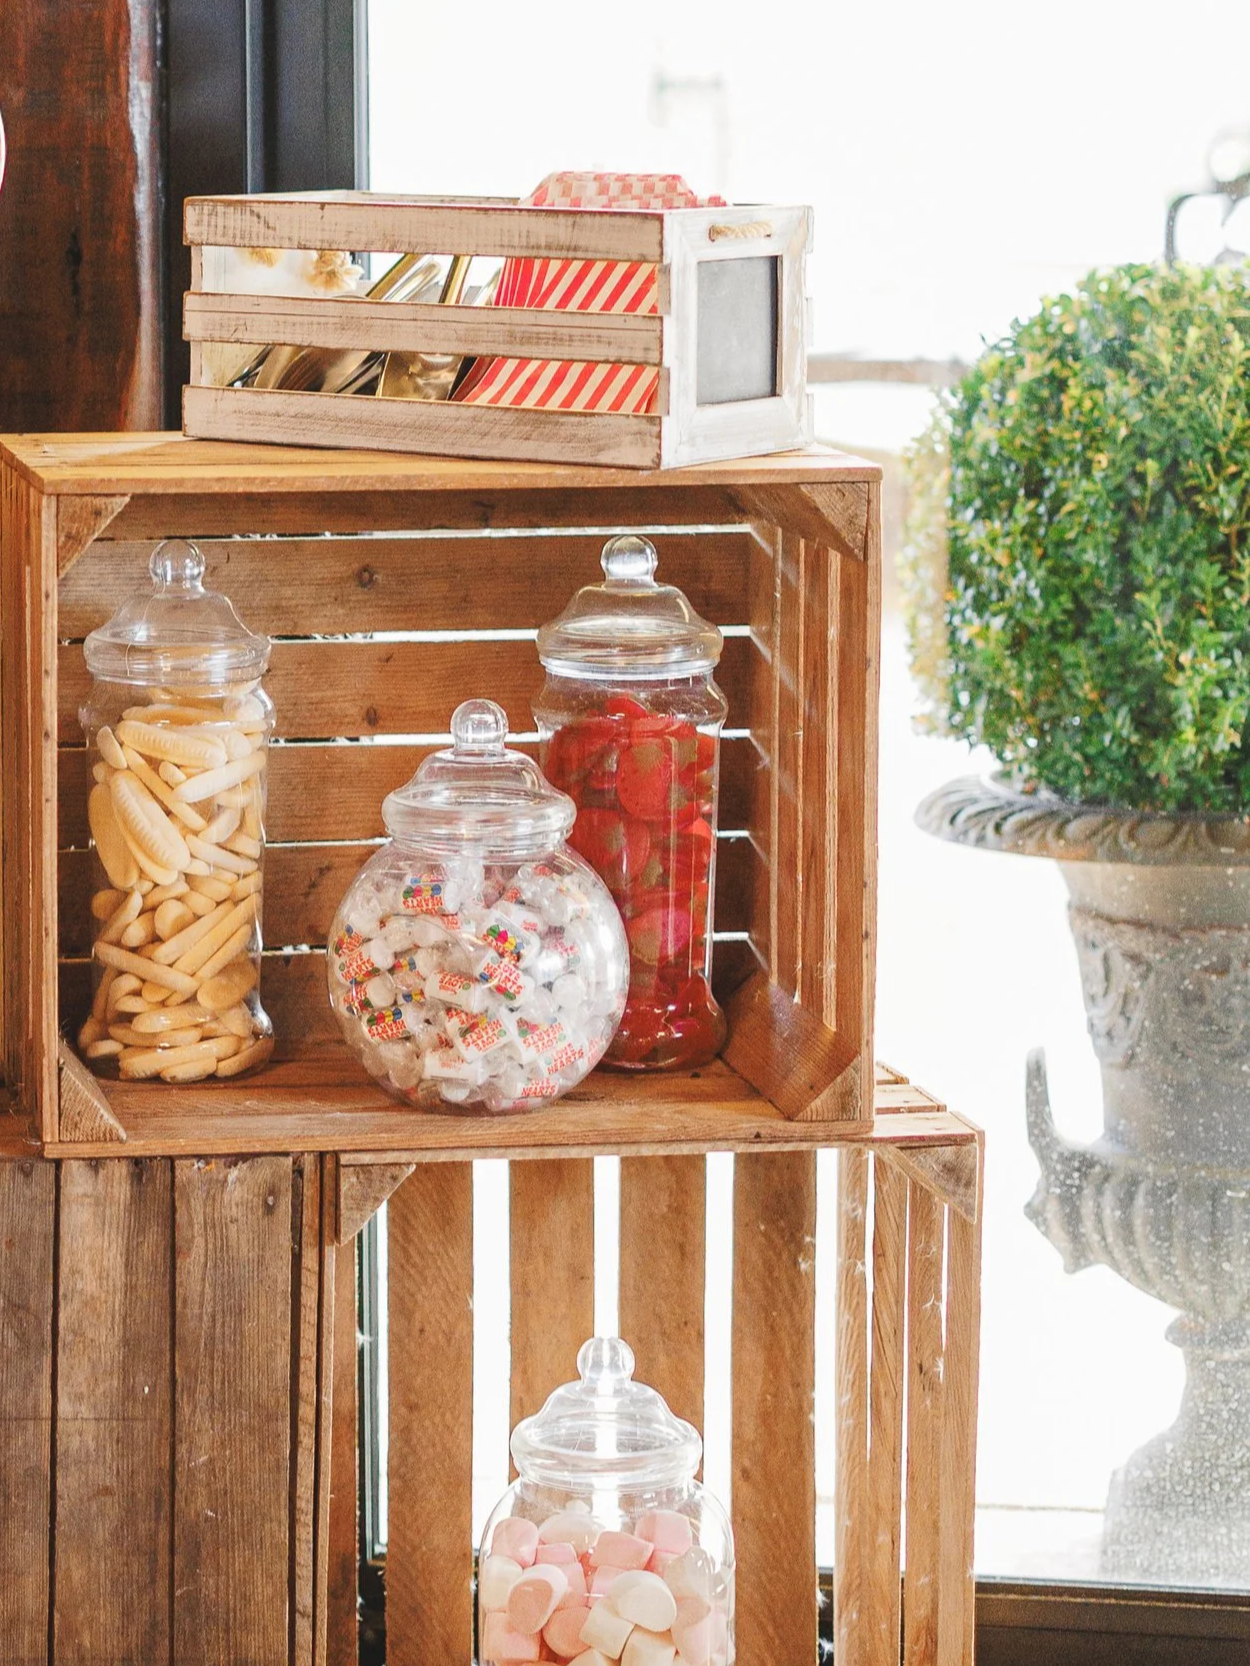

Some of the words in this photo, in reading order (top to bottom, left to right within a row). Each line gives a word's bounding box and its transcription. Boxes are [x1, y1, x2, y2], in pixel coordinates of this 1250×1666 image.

[341, 957, 375, 981] HEARTS
[461, 1018, 503, 1049] HEARTS
[522, 1085, 556, 1097] HEARTS
